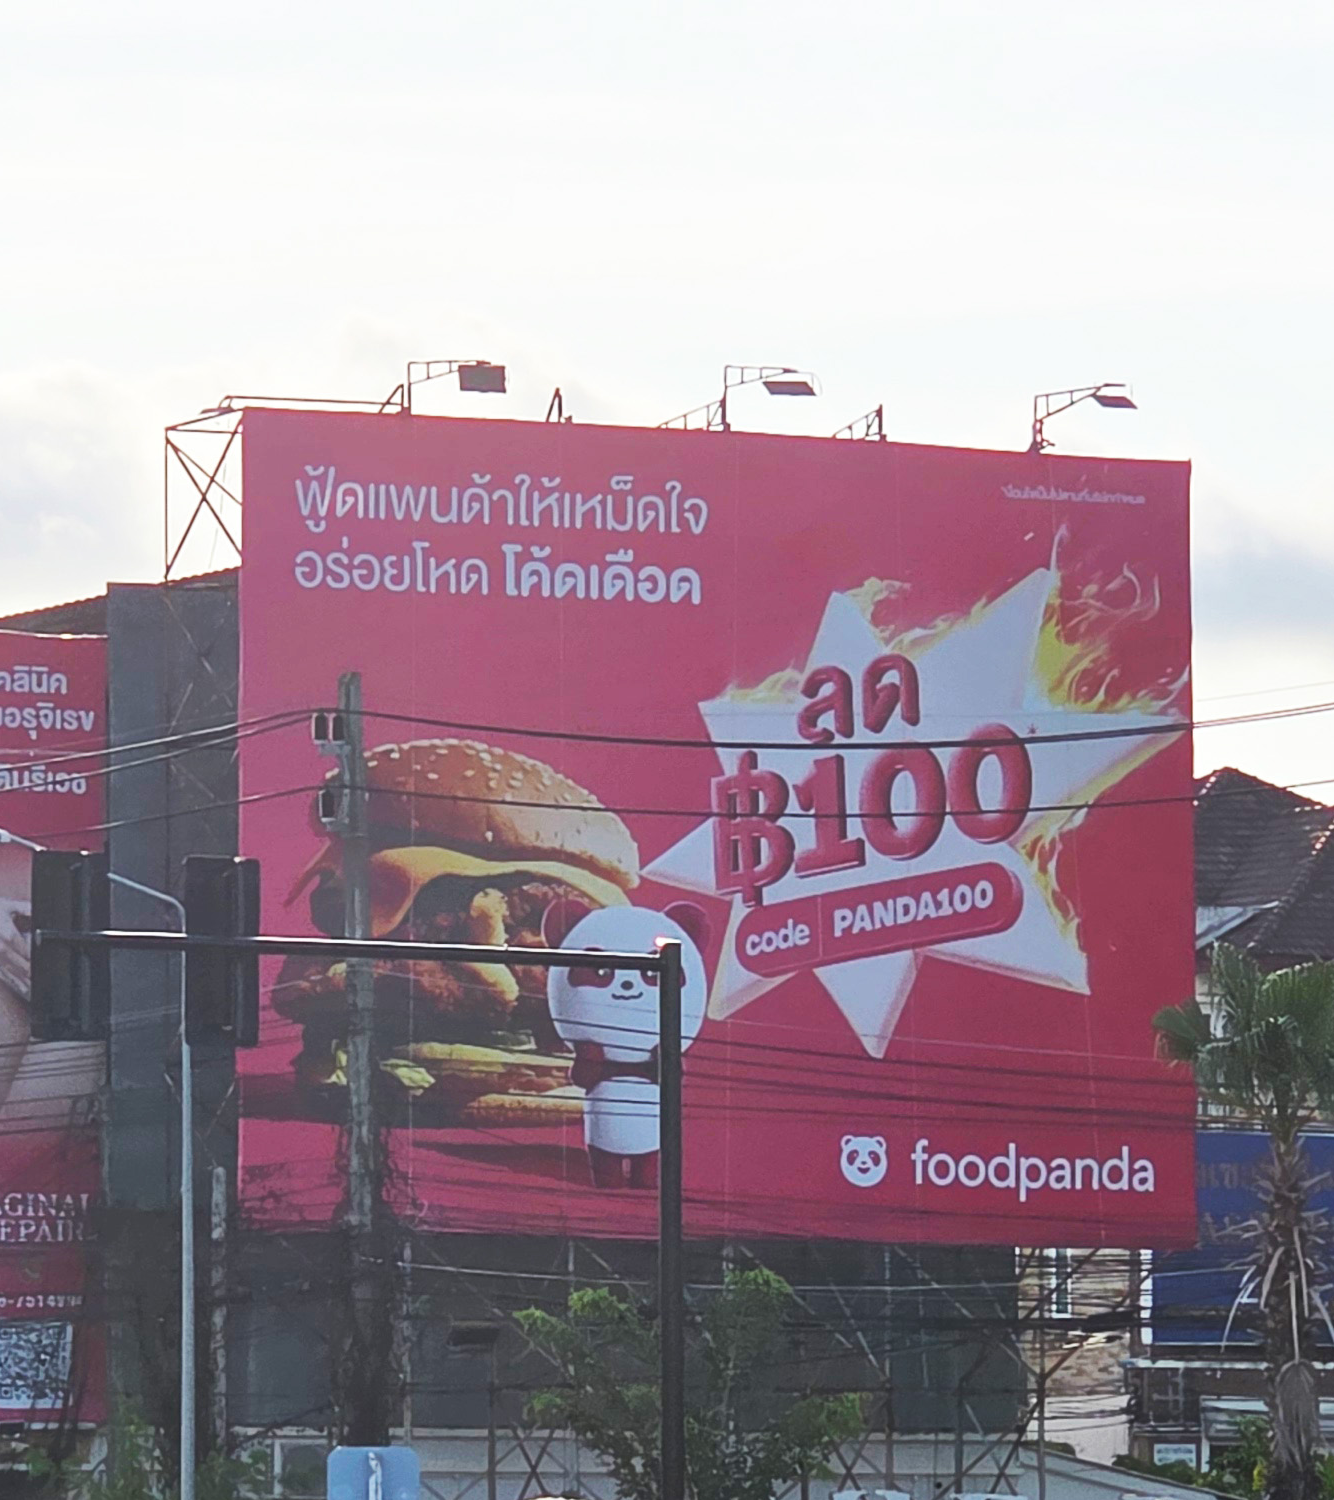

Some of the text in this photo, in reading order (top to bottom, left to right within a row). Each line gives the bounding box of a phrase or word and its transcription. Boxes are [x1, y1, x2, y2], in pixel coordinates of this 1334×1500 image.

[294, 537, 701, 604] อร่อยโหด โค้ดเดือด
[797, 653, 920, 743] ลด
[745, 880, 994, 956] code PANDA100
[911, 1139, 1155, 1202] foodpanda
